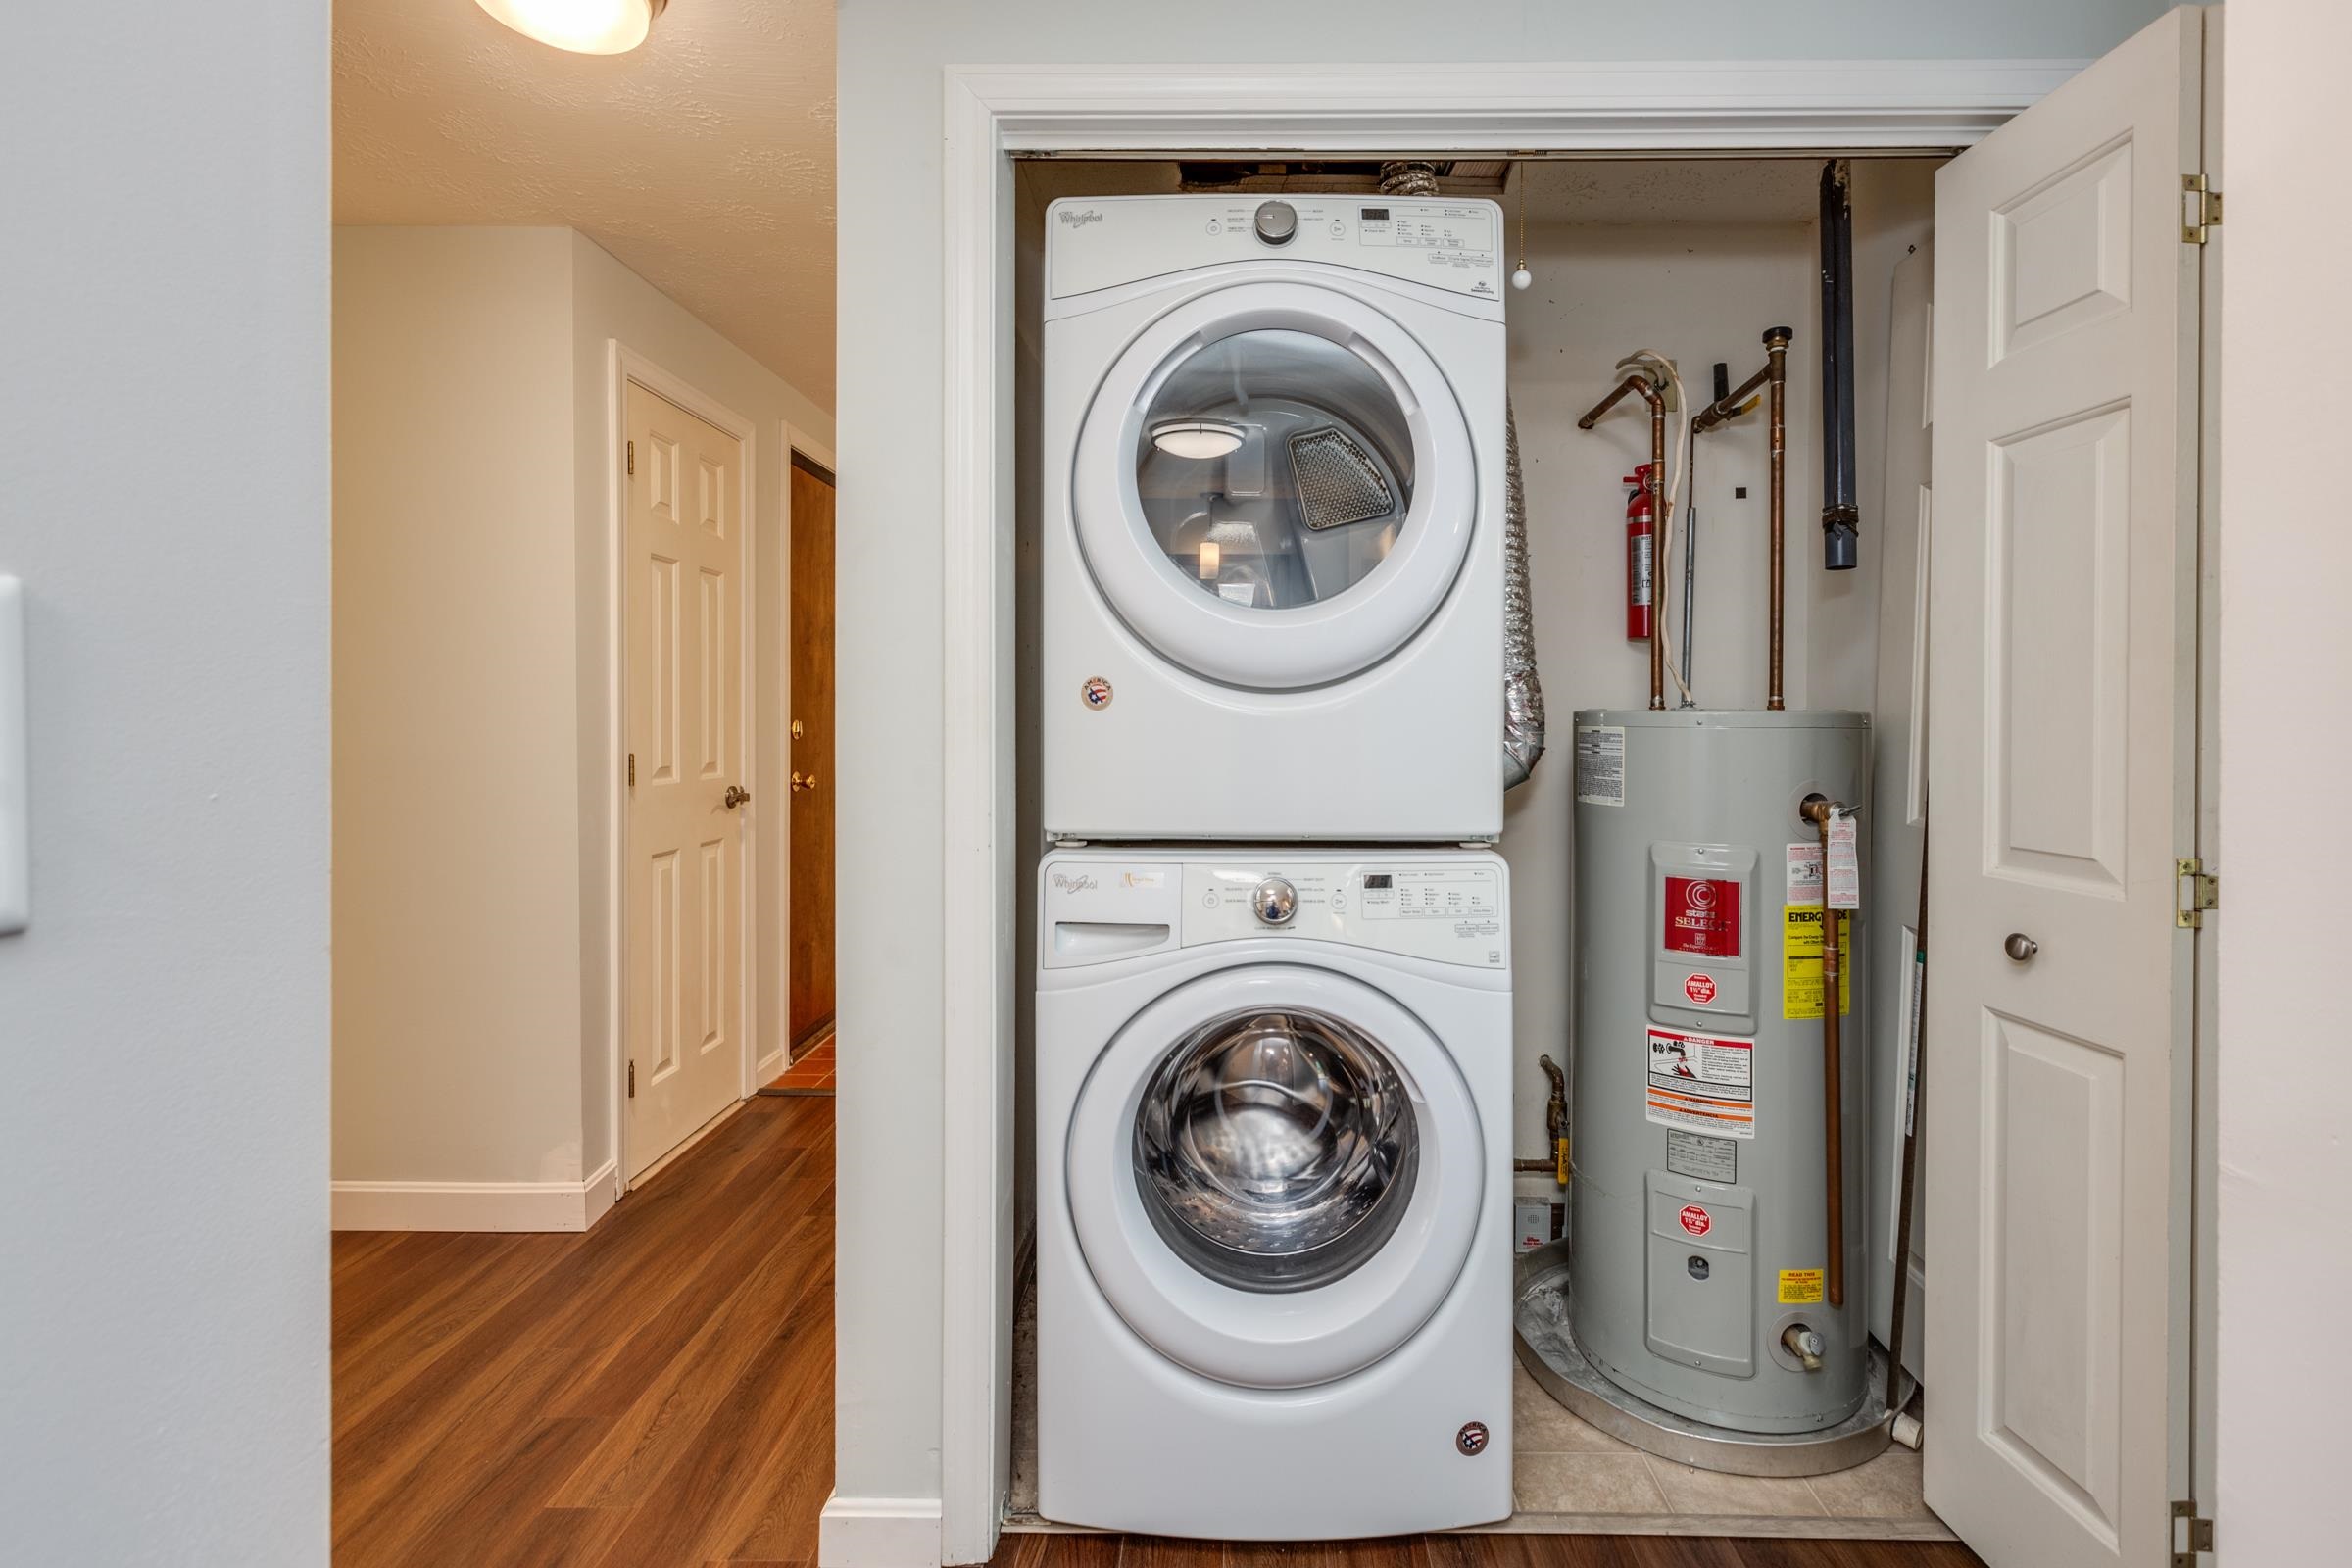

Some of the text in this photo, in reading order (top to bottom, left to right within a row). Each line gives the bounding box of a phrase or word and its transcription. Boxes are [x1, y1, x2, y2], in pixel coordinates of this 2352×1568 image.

[1058, 211, 1102, 228] Whirlpool
[1053, 874, 1098, 894] Whirlpool
[1459, 1421, 1488, 1436] AMERICA
